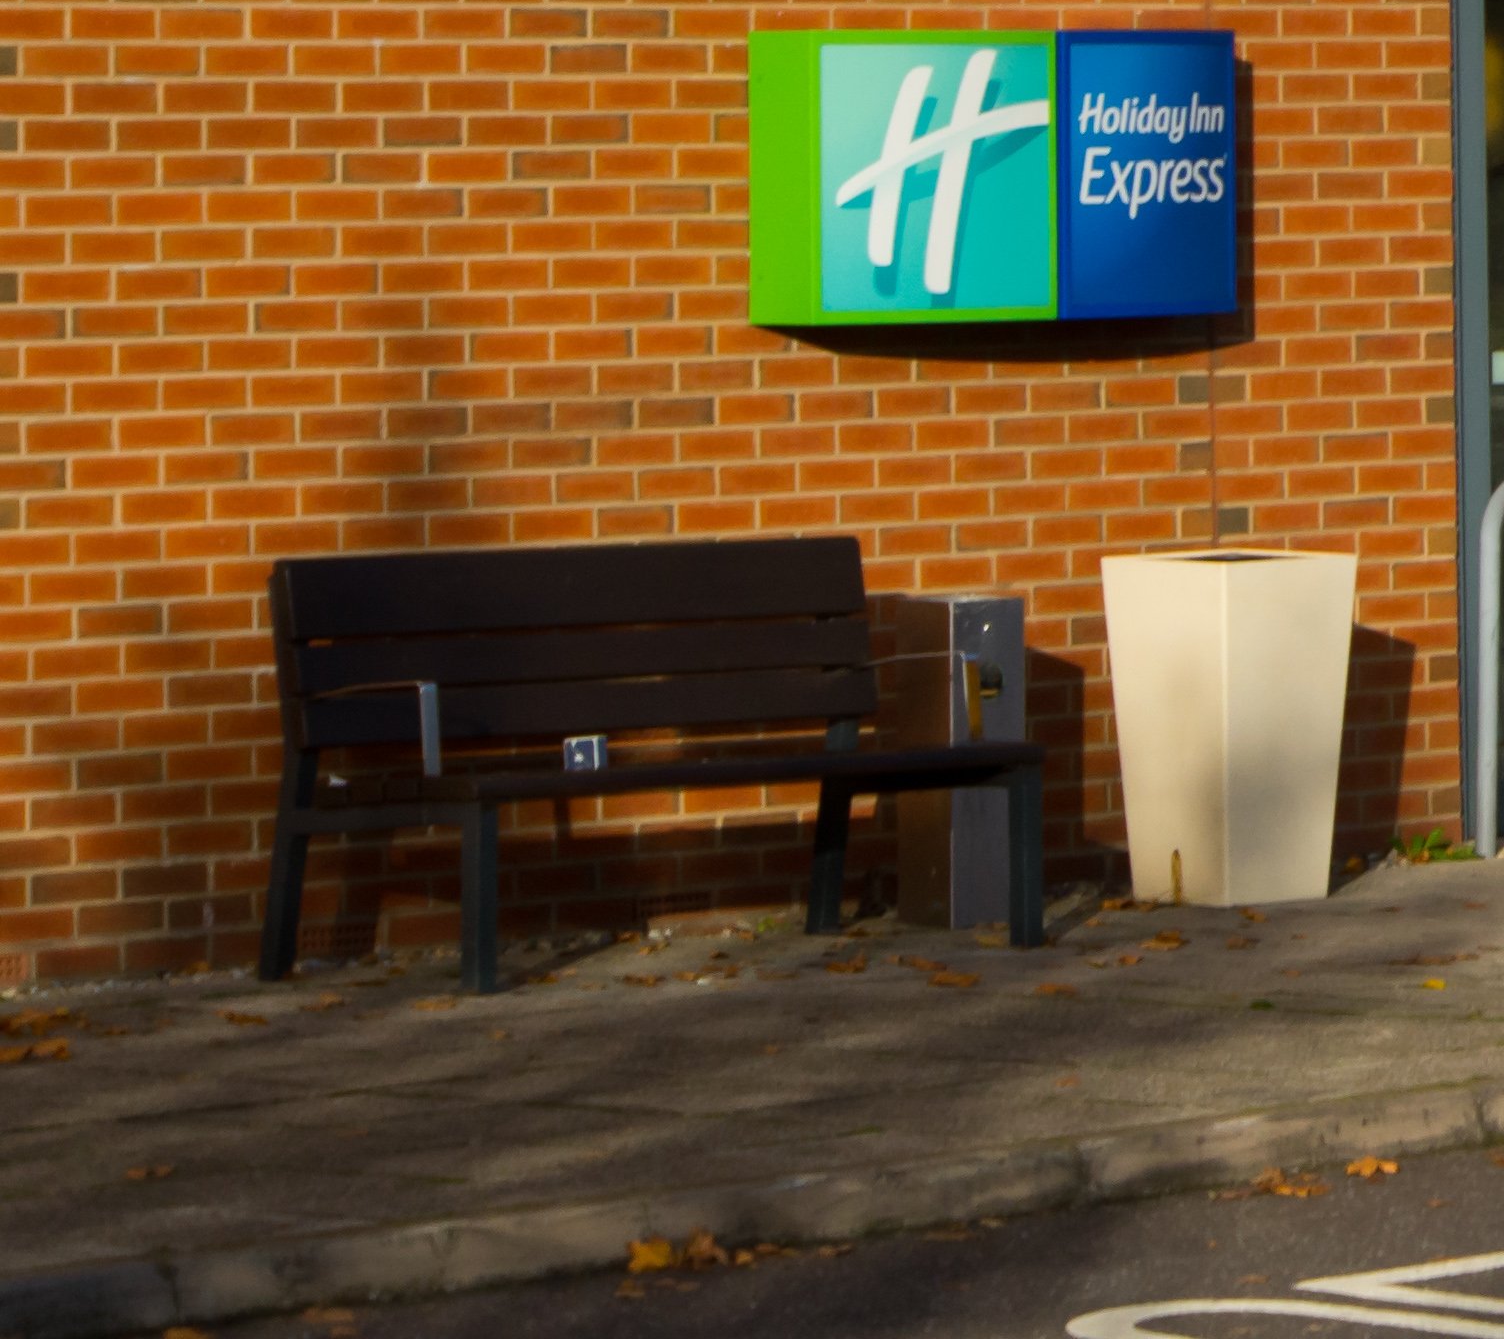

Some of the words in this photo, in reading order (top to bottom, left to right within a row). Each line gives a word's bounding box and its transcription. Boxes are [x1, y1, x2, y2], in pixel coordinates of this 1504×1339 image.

[1078, 91, 1188, 144] Holiday
[1189, 91, 1225, 134] Inn
[1079, 145, 1225, 220] Express
